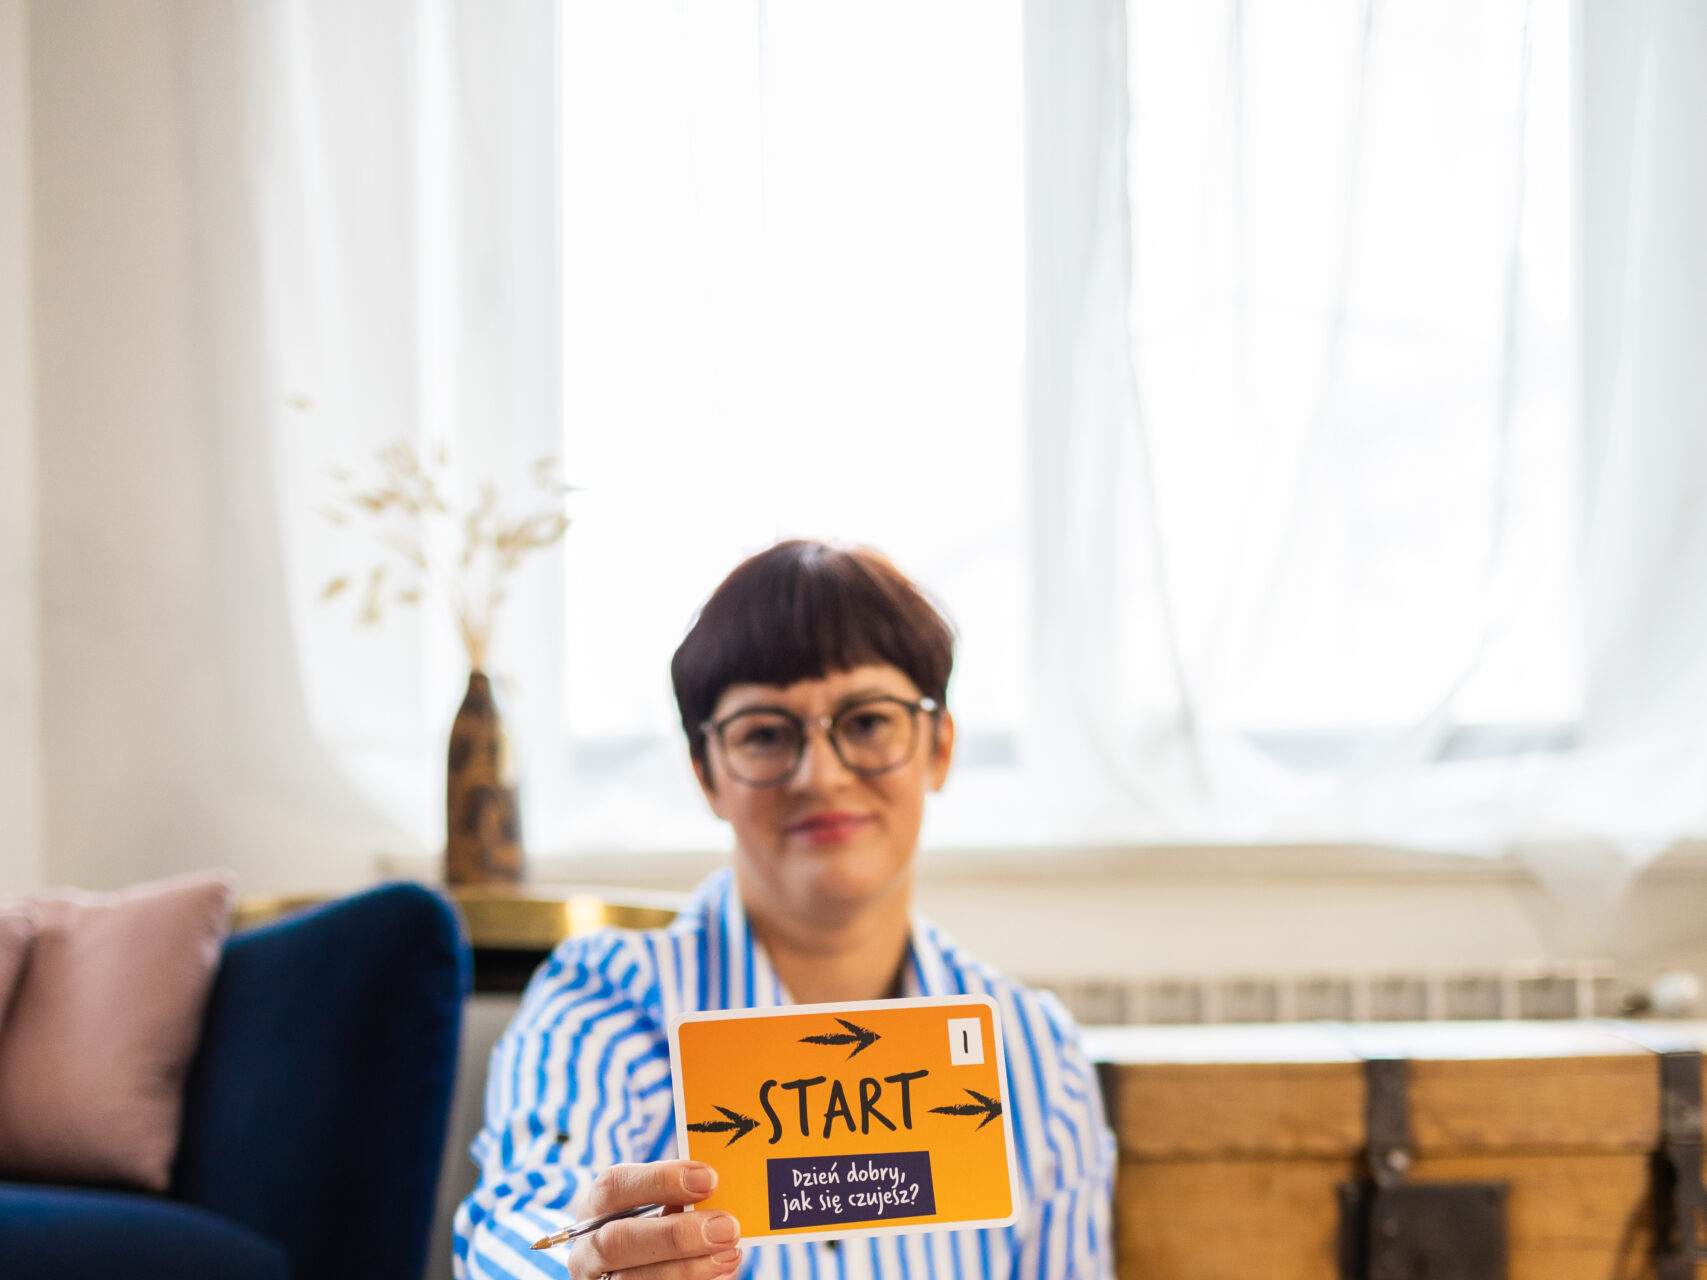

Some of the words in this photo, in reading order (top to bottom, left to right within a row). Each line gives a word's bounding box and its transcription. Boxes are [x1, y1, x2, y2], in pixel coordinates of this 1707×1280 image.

[962, 1029, 969, 1054] 1
[759, 1069, 929, 1144] START
[792, 1162, 839, 1188] Dzień
[847, 1160, 906, 1189] dobry,
[782, 1192, 812, 1222] jak
[819, 1190, 843, 1214] się
[848, 1183, 919, 1216] czujesz?
